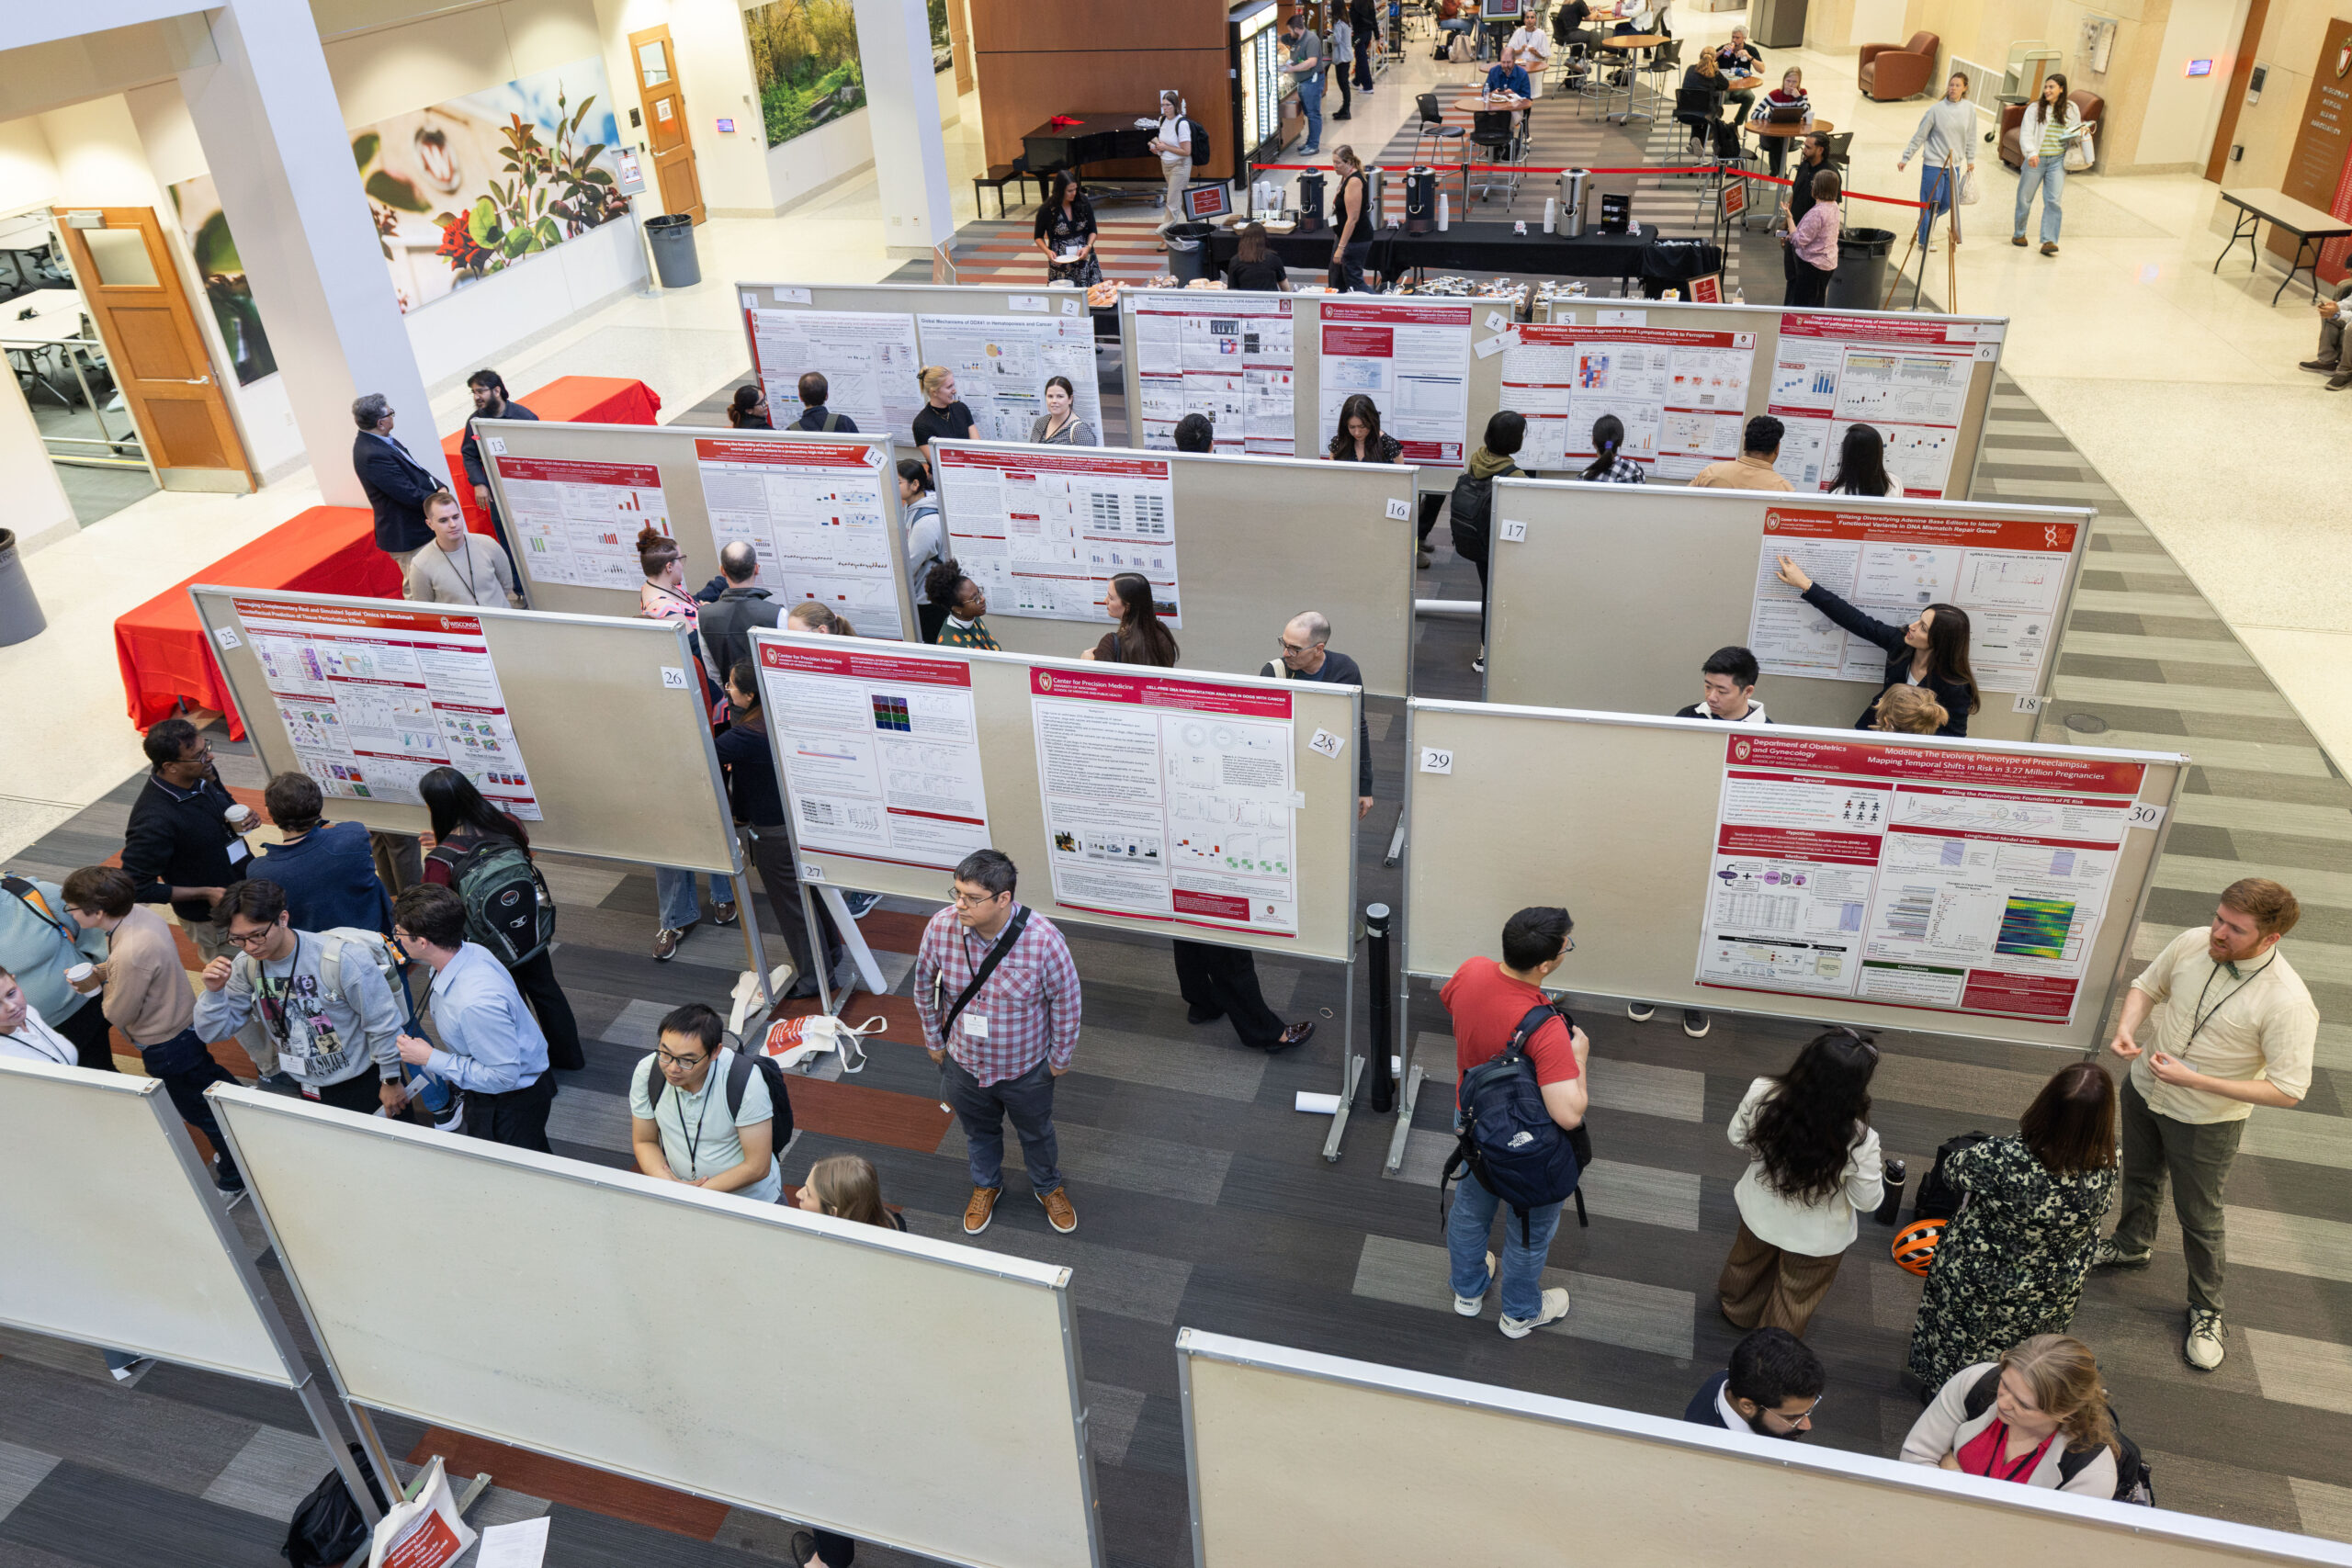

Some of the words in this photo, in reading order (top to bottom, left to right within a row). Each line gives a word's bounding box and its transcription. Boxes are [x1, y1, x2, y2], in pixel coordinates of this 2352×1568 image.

[1067, 303, 1073, 312] 2
[1492, 318, 1499, 327] 4
[1564, 315, 1571, 325] 5
[1982, 347, 1990, 358] 6
[492, 441, 504, 452] 13
[868, 451, 883, 466] 14
[1390, 502, 1406, 516] 16
[1836, 513, 1860, 522] Utilizing
[1862, 515, 1899, 524] Diversifying
[1977, 521, 2002, 529] Identify
[1508, 524, 1524, 537] 17
[236, 601, 260, 609] Leveraging
[261, 603, 298, 612] Complementary
[318, 615, 347, 623] Perturbation
[220, 631, 237, 645] 25
[664, 671, 682, 684] 26
[1108, 682, 1134, 690] Medicine
[2018, 697, 2036, 709] 18
[1313, 733, 1336, 751] 28
[1753, 739, 1798, 748] Department
[1808, 743, 1847, 751] Obstetrics
[1738, 747, 1747, 756] W
[1769, 748, 1815, 759] Gynecology
[1427, 752, 1450, 768] 29
[1884, 747, 1922, 758] Modeling
[1925, 750, 1939, 758] The
[1941, 751, 1973, 761] Evolving
[1976, 754, 2020, 765] Phenotype
[2032, 758, 2090, 770] Preeclampsia:
[1867, 755, 1902, 766] Mapping
[1905, 758, 1940, 768] Temporal
[1942, 761, 1964, 770] Shifts
[2005, 766, 2022, 774] 3.27
[2024, 768, 2052, 776] Million
[2054, 770, 2104, 781] Pregnancies
[1977, 792, 2020, 800] Polyphenotypic
[2128, 806, 2156, 822] 30
[804, 866, 820, 877] 27
